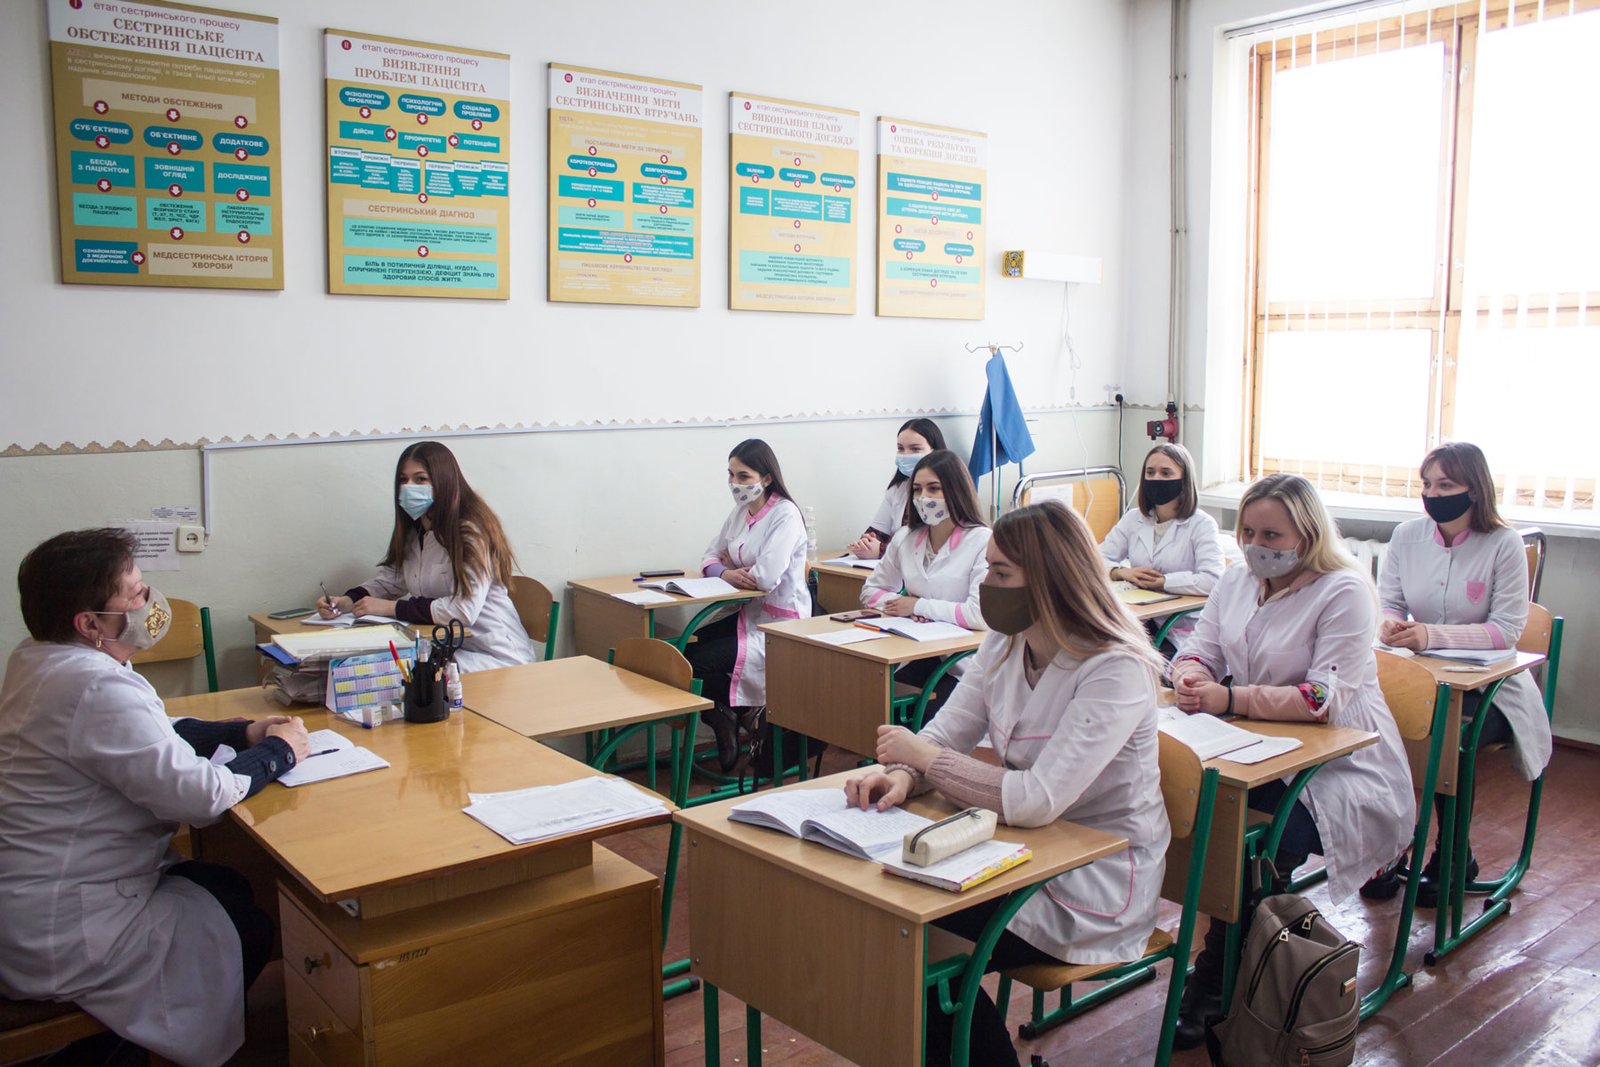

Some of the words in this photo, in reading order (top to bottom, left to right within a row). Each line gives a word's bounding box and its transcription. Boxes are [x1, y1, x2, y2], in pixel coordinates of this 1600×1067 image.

[94, 2, 118, 12] етап
[121, 8, 196, 24] сестринського
[200, 18, 240, 30] процесу
[114, 18, 224, 43] СЕСТРИНСЬКЕ
[67, 26, 180, 52] ОБСТЕЖЕННЯ
[186, 43, 264, 62] ПАЦІЄНТА
[362, 44, 381, 52] етап
[384, 46, 444, 61] сестринського
[446, 56, 480, 67] процесу
[383, 58, 460, 77] ВИЯВЛЕННЯ
[355, 67, 416, 84] ПРОБЛЕМ
[422, 76, 486, 93] ПАЦІЄНТА
[598, 78, 648, 92] сестринського
[650, 86, 677, 97] процесу
[122, 93, 160, 104] МЕТОДИ
[163, 98, 223, 110] ОБСТЕЖЕННЯ
[348, 97, 382, 105] ПРОБЛЕМИ
[576, 86, 648, 105] ВИЗНАЧЕННЯ
[653, 98, 681, 110] МЕТИ
[406, 104, 438, 112] ПРОБЛЕМИ
[556, 96, 641, 115] СЕСТРИНСЬКИХ
[644, 108, 698, 123] ВТРУЧАНЬ
[752, 113, 809, 128] ВИКОНАННЯ
[220, 137, 263, 148] ДОДАТКОВЕ
[738, 122, 812, 139] СЕСТРИНСЬКОГО
[815, 133, 854, 145] ДОГЛЯДУ
[85, 165, 130, 174] ПАЦІЄНТОМ
[218, 172, 267, 181] ДОСЛІДЖЕННЯ
[368, 205, 437, 216] СЕСТРИНСЬКИЙ
[440, 210, 475, 219] ДІАГНОЗ
[153, 252, 234, 261] МЕДСЕСТРИНСЬКА
[192, 261, 233, 270] ХВОРОБИ
